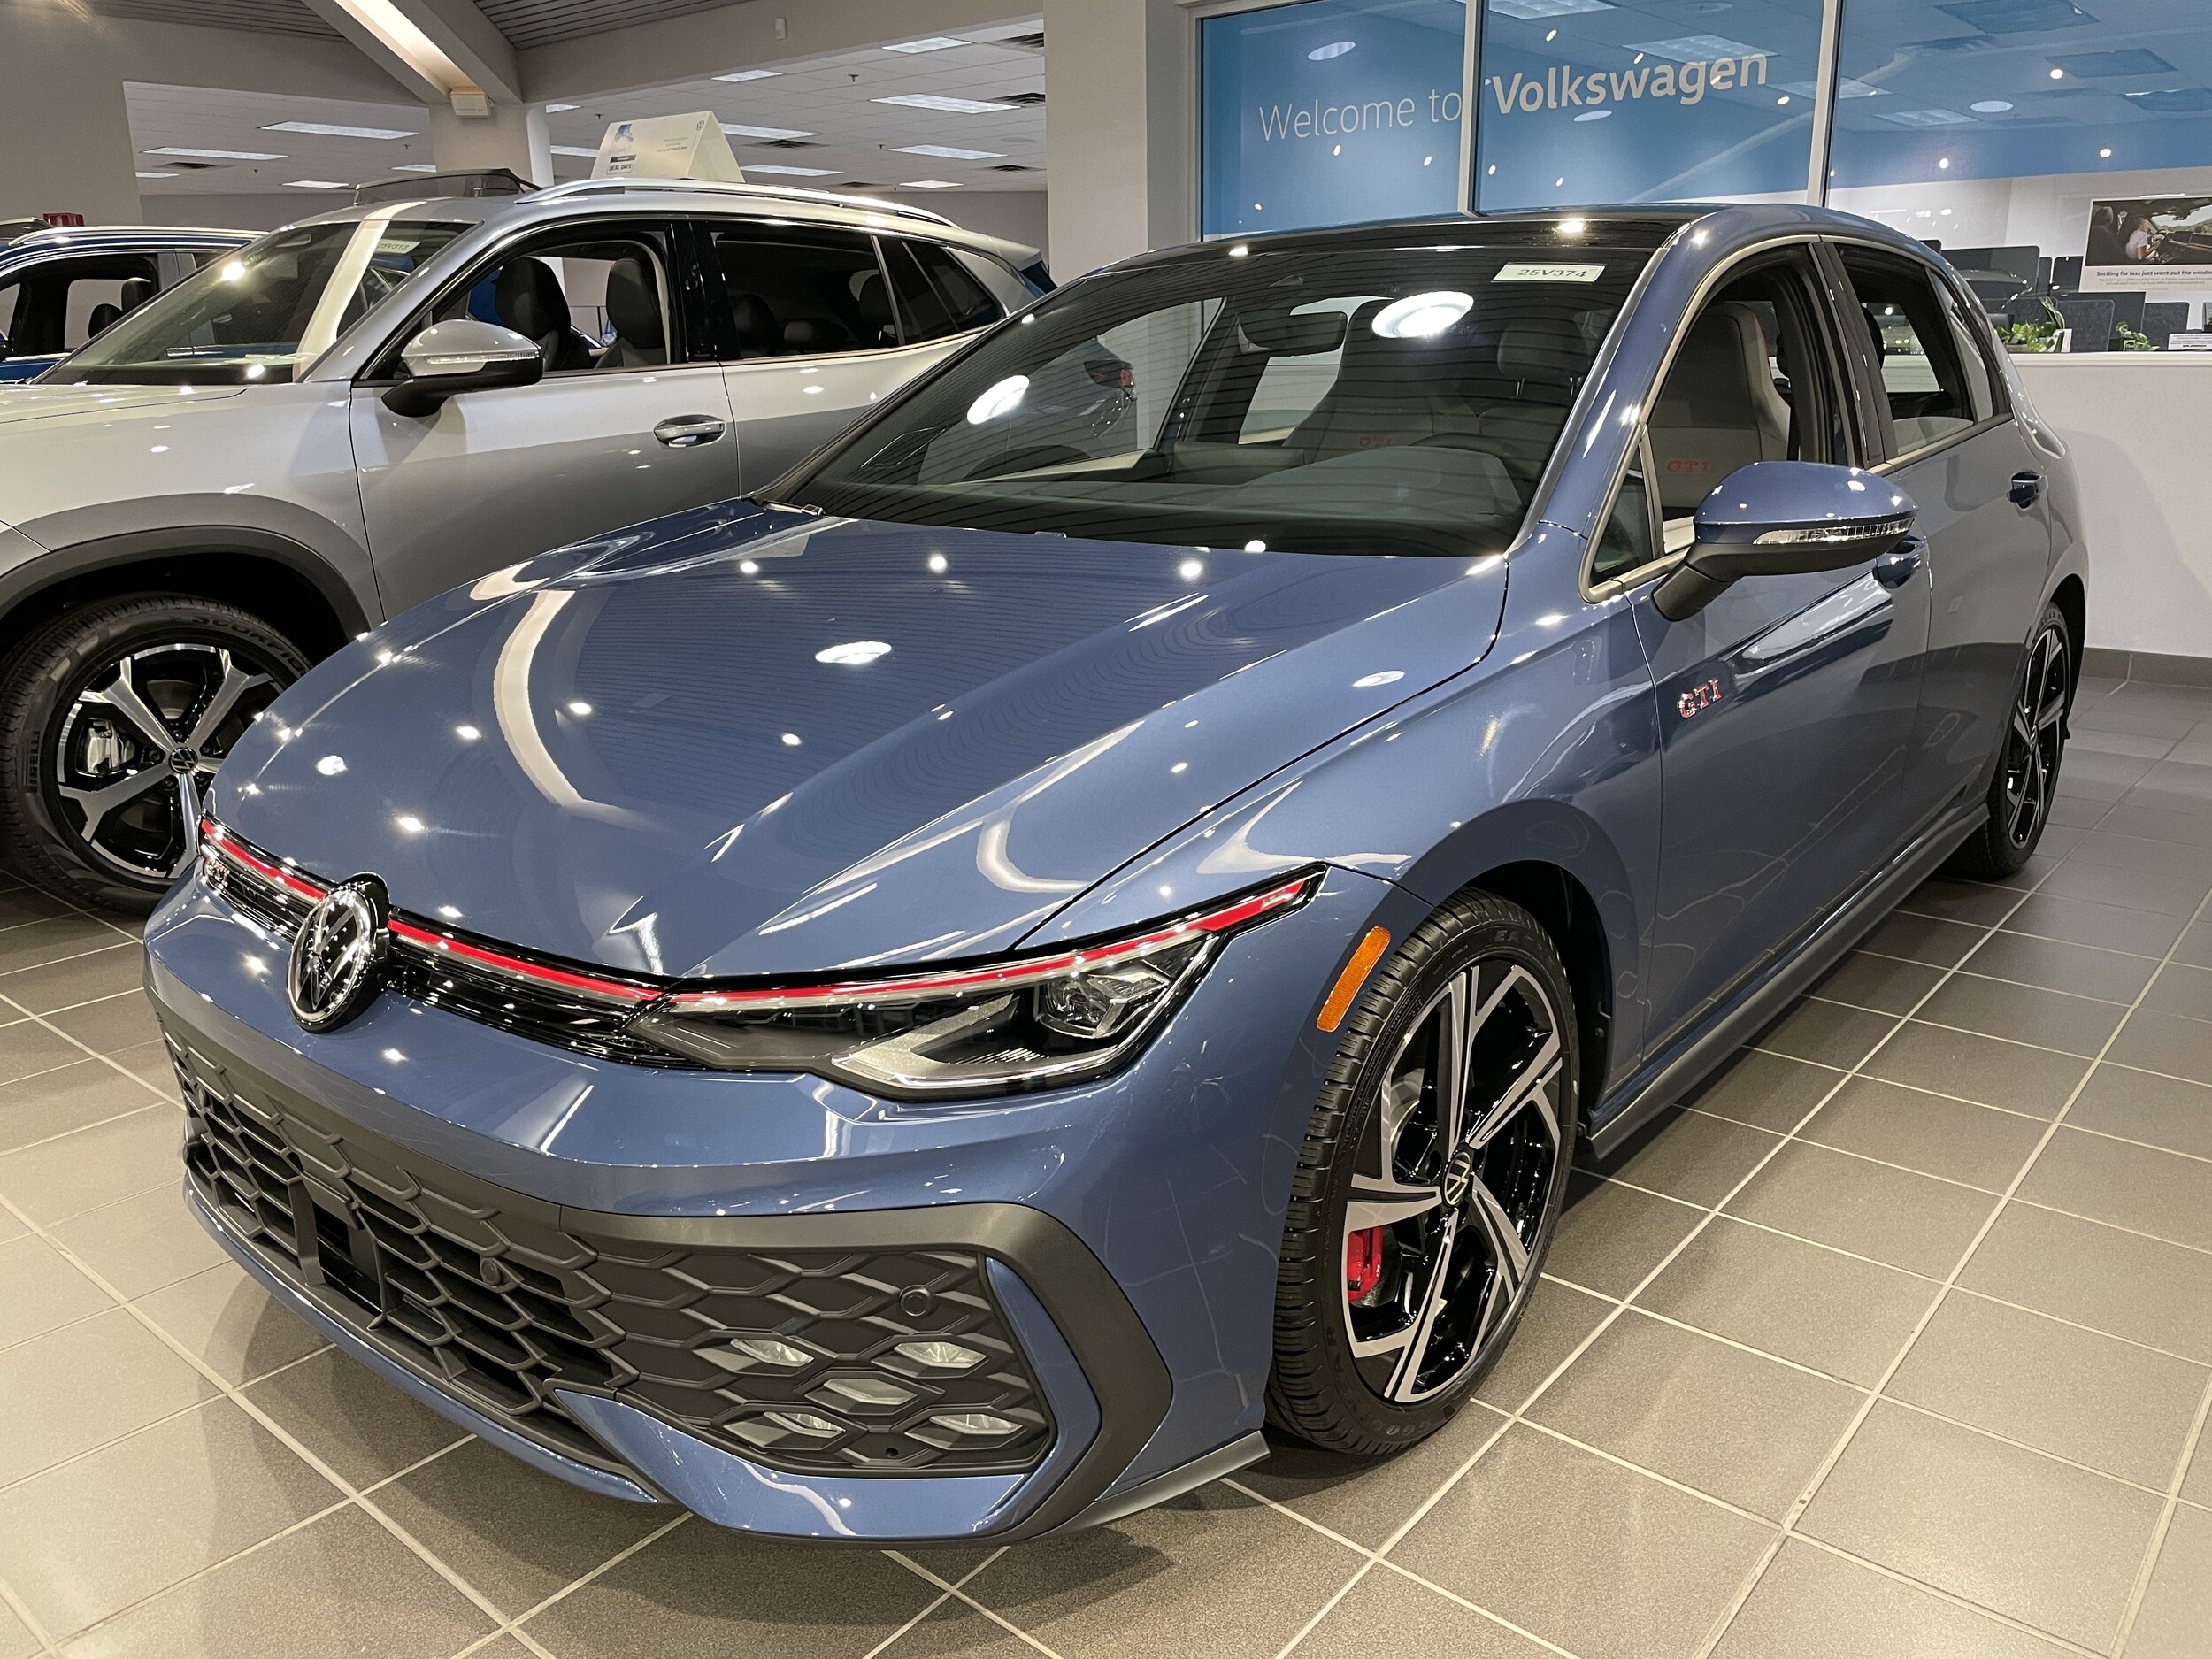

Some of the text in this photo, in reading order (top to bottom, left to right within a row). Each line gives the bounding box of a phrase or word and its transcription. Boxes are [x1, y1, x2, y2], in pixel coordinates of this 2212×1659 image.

[1258, 53, 1768, 142] Welcome to Volkswagen
[1666, 459, 1710, 474] GTI
[1677, 679, 1722, 718] GTI
